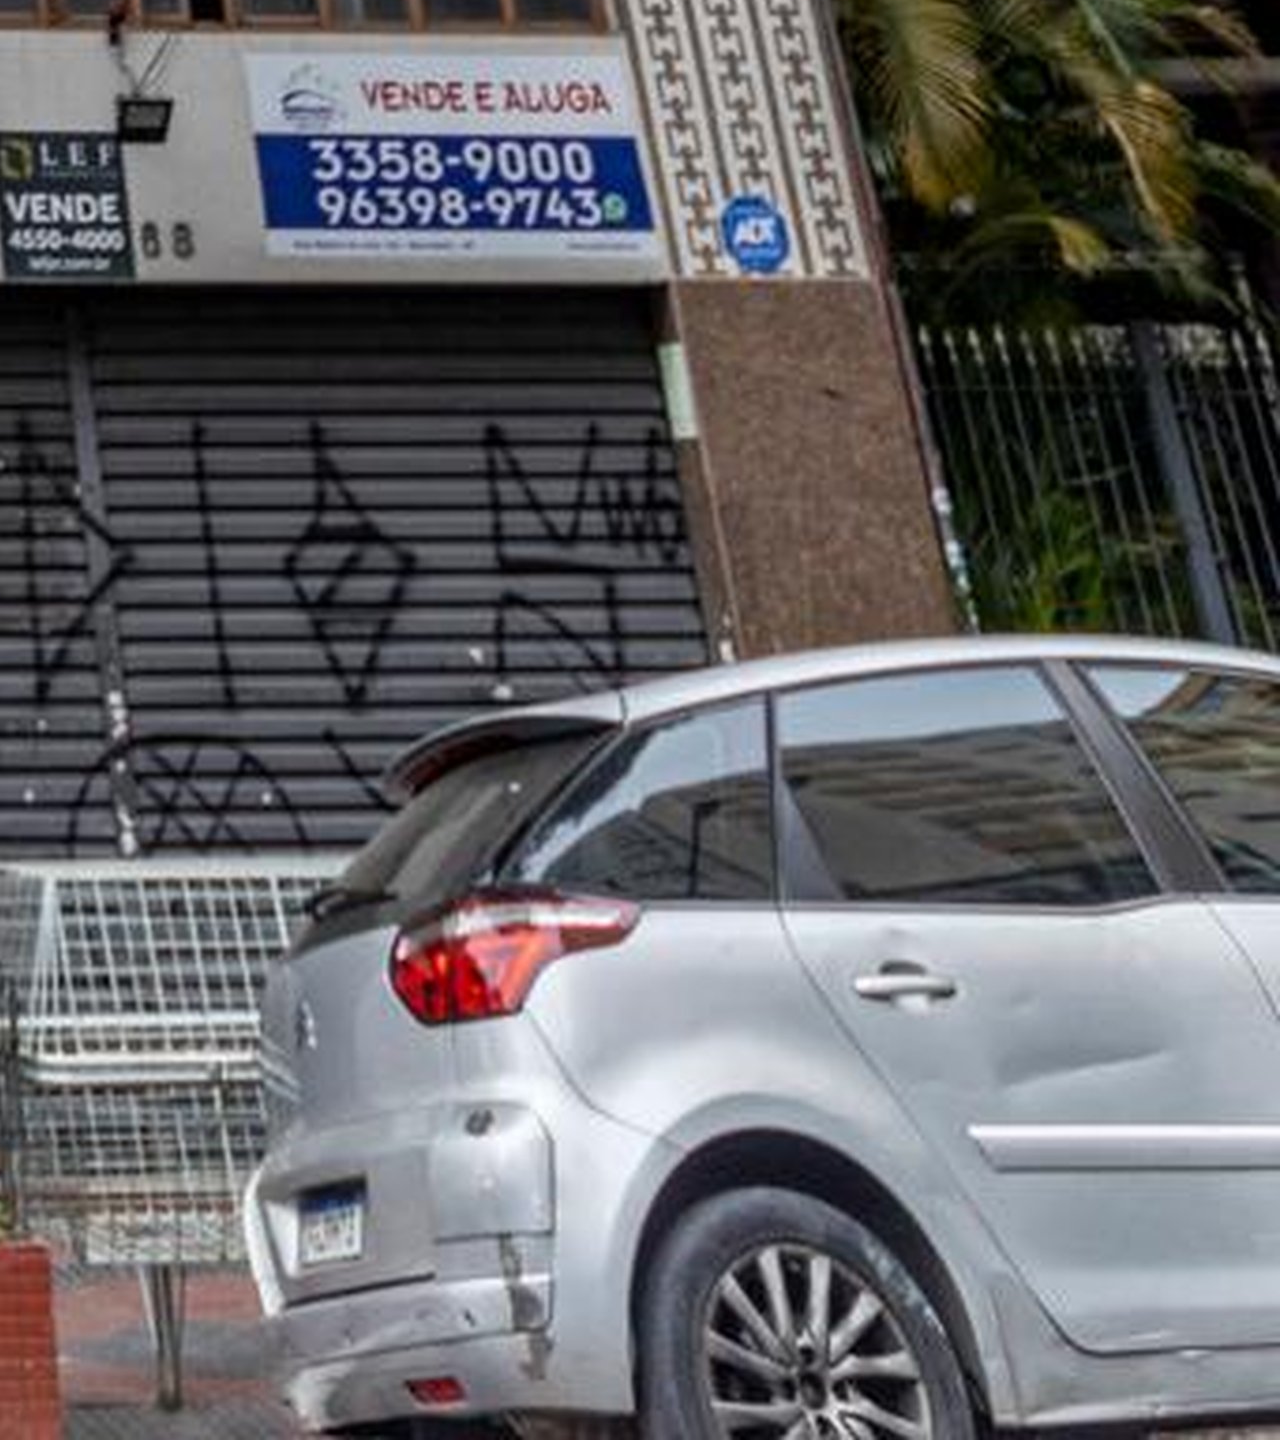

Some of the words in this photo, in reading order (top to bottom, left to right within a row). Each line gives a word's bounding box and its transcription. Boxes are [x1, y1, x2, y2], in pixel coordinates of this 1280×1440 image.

[360, 81, 467, 112] VENDE
[474, 81, 495, 112] E
[503, 82, 612, 114] ALUGA
[309, 140, 594, 183] 3358-9000
[4, 193, 121, 223] VENDE
[318, 187, 602, 227] 96398-9743
